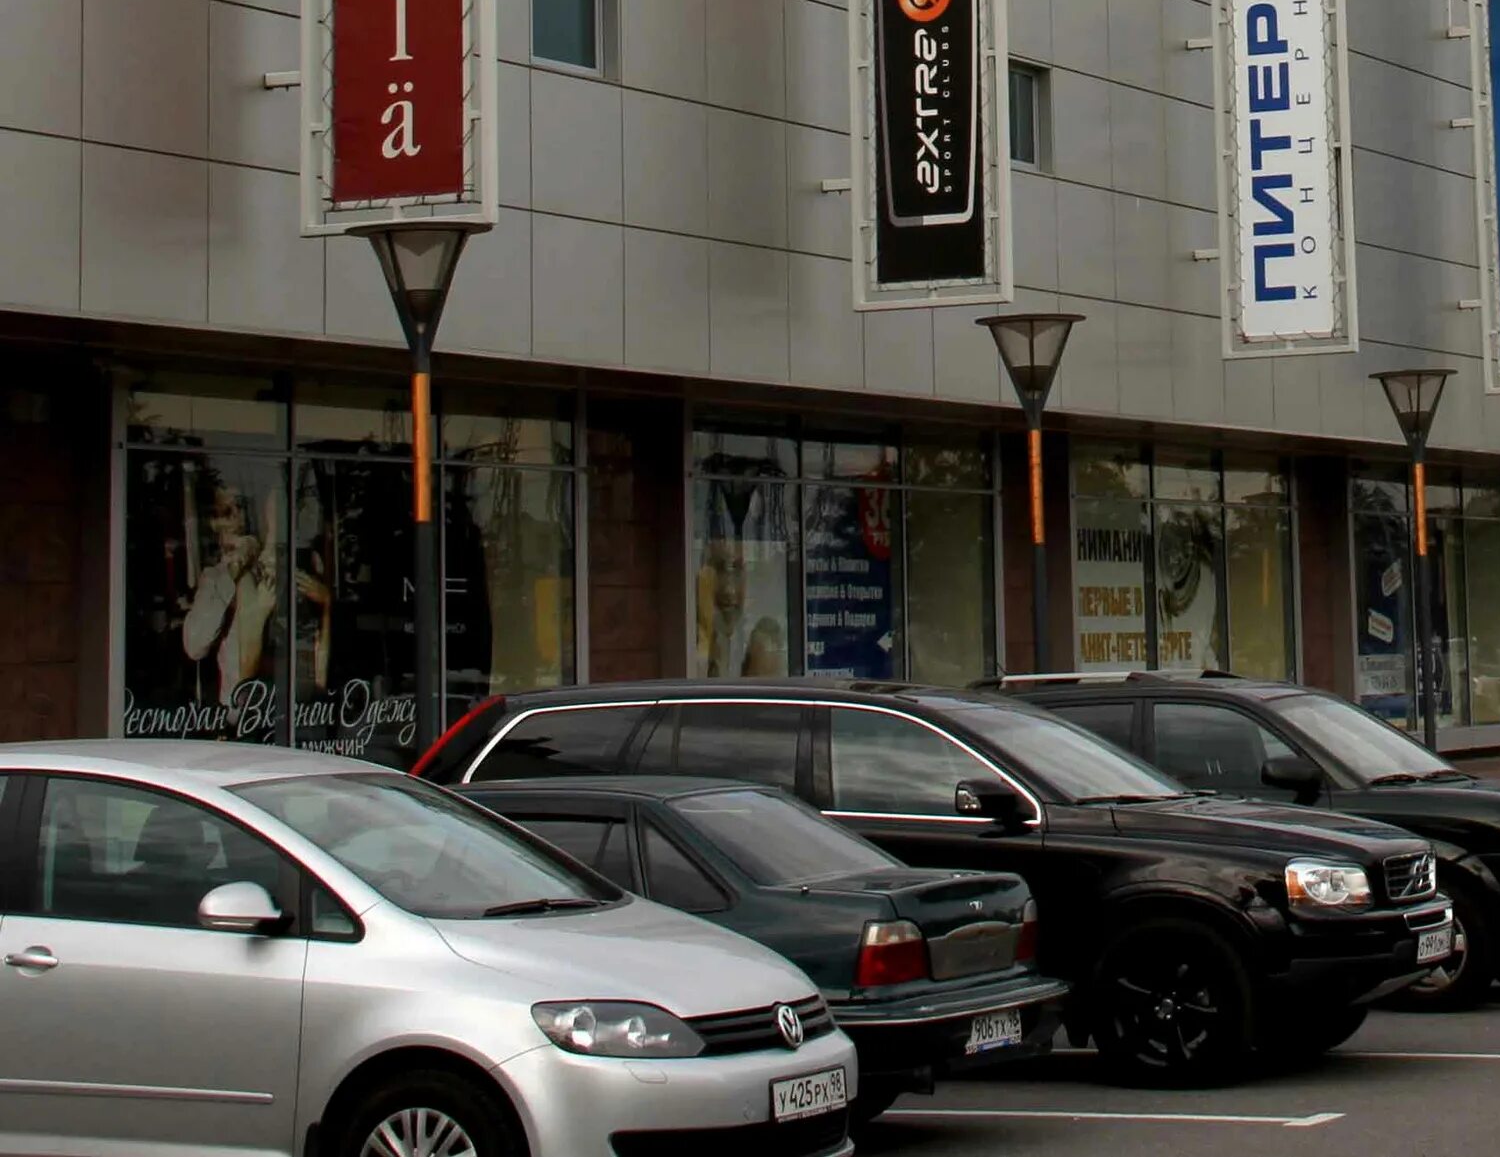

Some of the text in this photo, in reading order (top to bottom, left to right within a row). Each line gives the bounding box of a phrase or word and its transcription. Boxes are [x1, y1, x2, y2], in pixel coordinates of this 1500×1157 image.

[941, 25, 950, 98] CLUBS
[1247, 2, 1297, 302] ПИТЕР
[1292, 0, 1318, 300] КОНЦЕРН
[943, 118, 952, 193] SPORT
